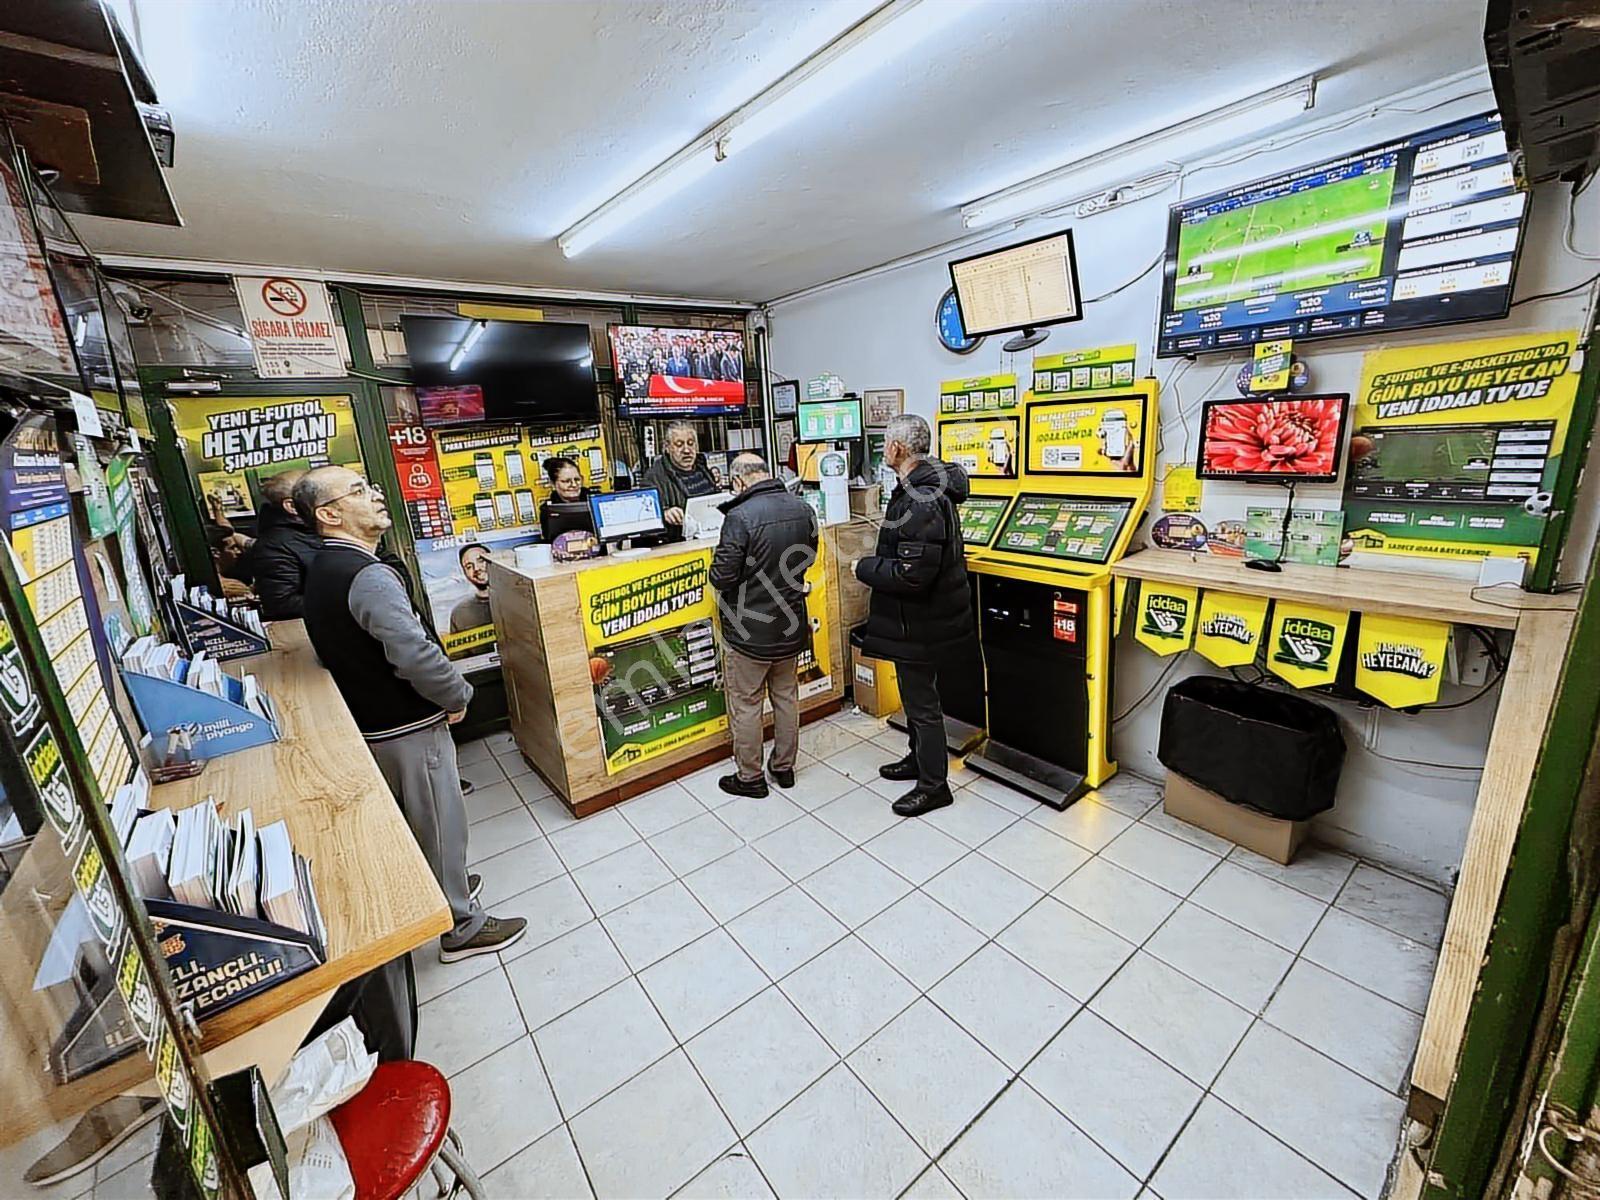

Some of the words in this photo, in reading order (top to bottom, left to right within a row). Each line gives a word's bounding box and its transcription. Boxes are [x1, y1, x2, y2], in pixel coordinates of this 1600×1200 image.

[252, 319, 291, 338] SİGARA
[292, 319, 332, 340] İÇİLMEZ
[1374, 366, 1428, 385] E-FUTBOL
[1431, 364, 1448, 375] VE
[1449, 343, 1567, 374] E-BASKETBOL'DA
[1369, 383, 1407, 404] GÜN
[1409, 377, 1463, 398] BOYU
[1464, 359, 1568, 391] HEYECAN
[1486, 380, 1552, 403] TV'DE
[209, 412, 247, 430] YENİ
[251, 401, 322, 424] E-FUTBOL
[204, 414, 335, 458] HEYECANI
[390, 427, 427, 445] +18
[272, 441, 327, 461] BAYİDE
[591, 602, 621, 624] GÜN
[622, 592, 655, 616] BOYU
[656, 570, 708, 602] HEYECAN
[671, 587, 703, 611] TV'DE
[1149, 596, 1186, 614] iddaa
[1054, 619, 1075, 632] +18
[1285, 620, 1332, 640] iddaa
[1361, 652, 1438, 679] HEYECANA?
[204, 718, 231, 733] milli
[206, 722, 254, 741] piyango
